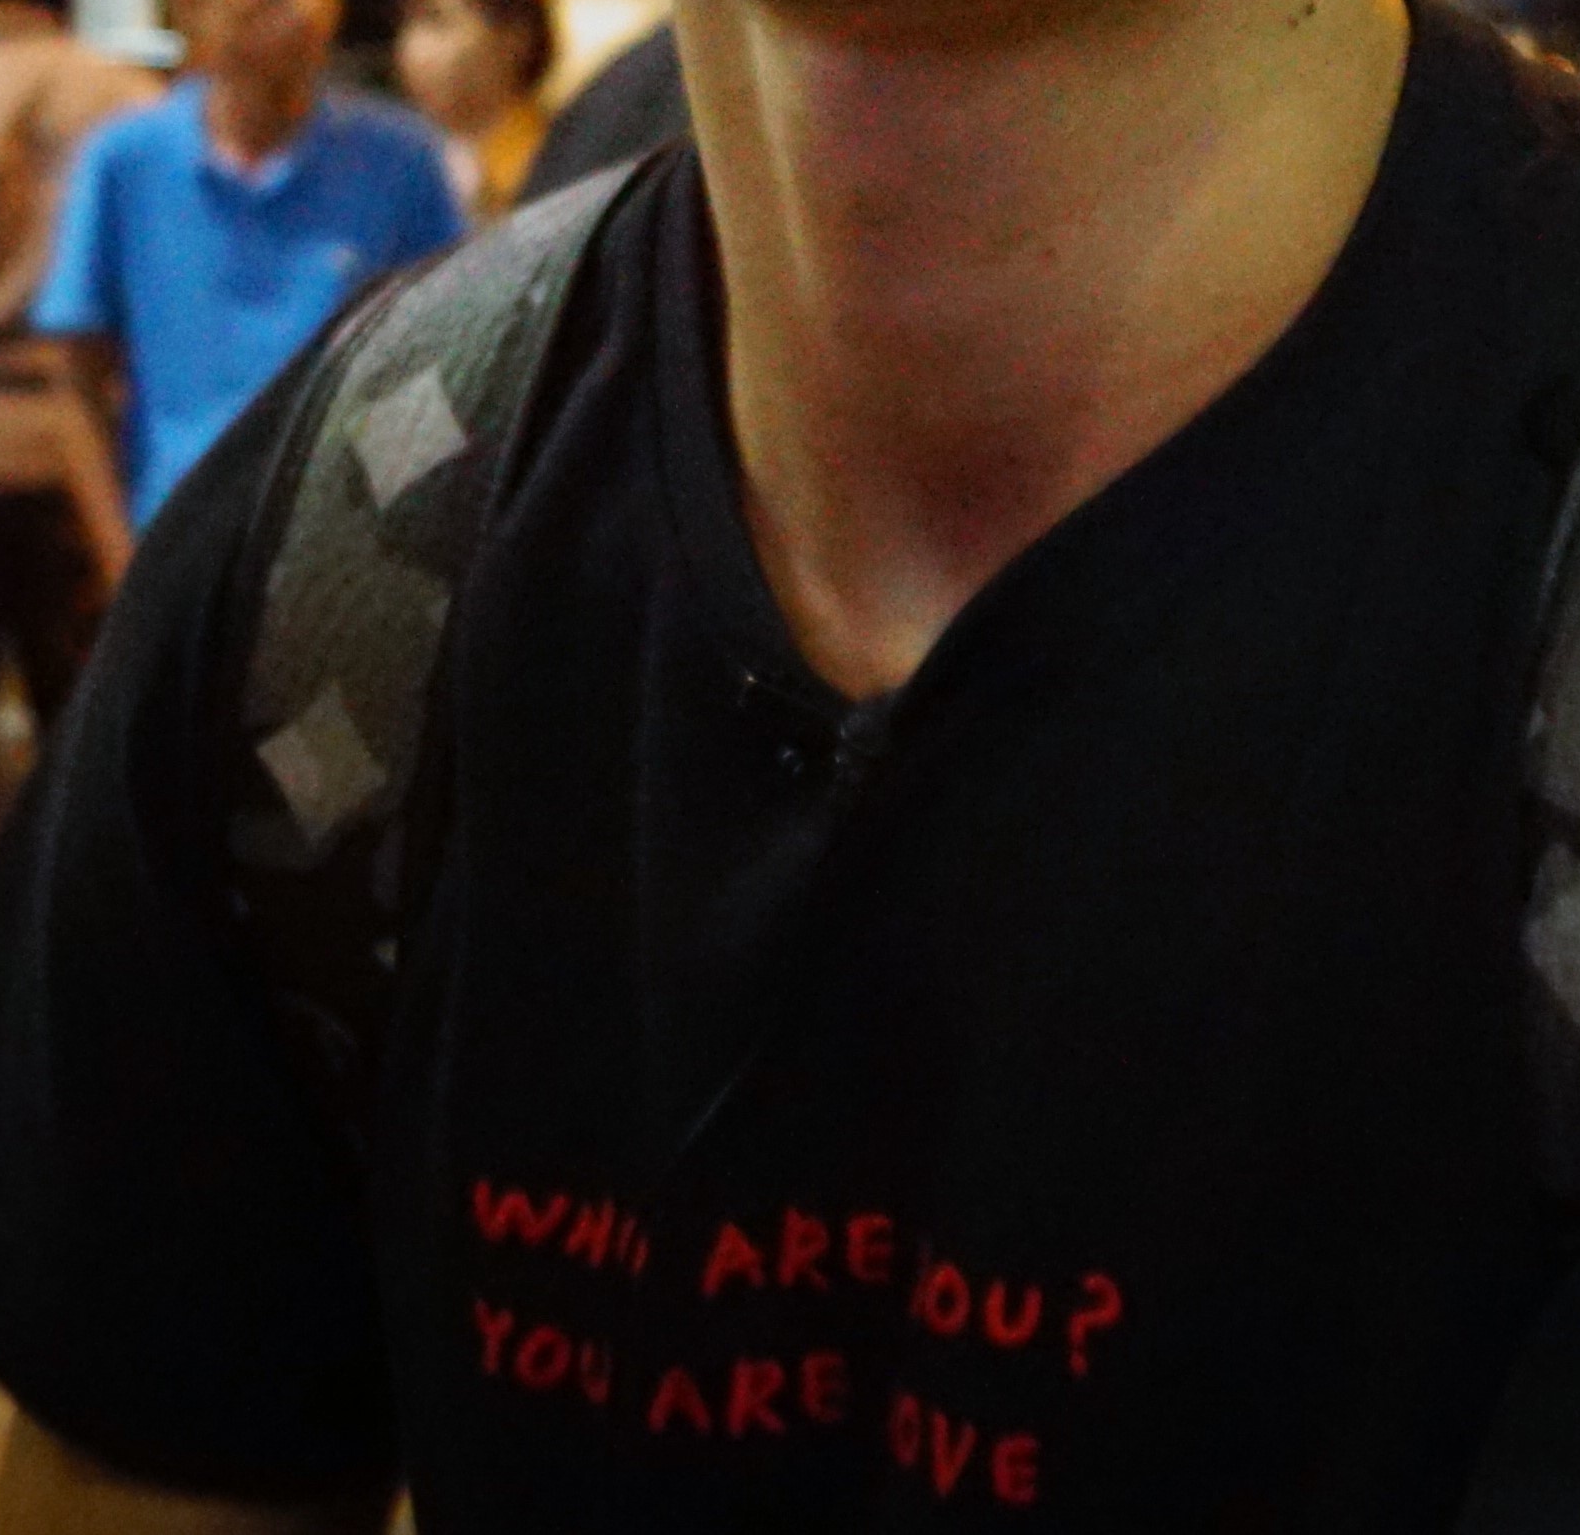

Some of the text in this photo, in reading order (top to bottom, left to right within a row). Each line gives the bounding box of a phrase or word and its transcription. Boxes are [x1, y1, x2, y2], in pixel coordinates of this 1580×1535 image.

[473, 1299, 612, 1405] YOU
[646, 1350, 842, 1434] ARE
[699, 1207, 893, 1295] ARE
[907, 1254, 1125, 1376] OU?
